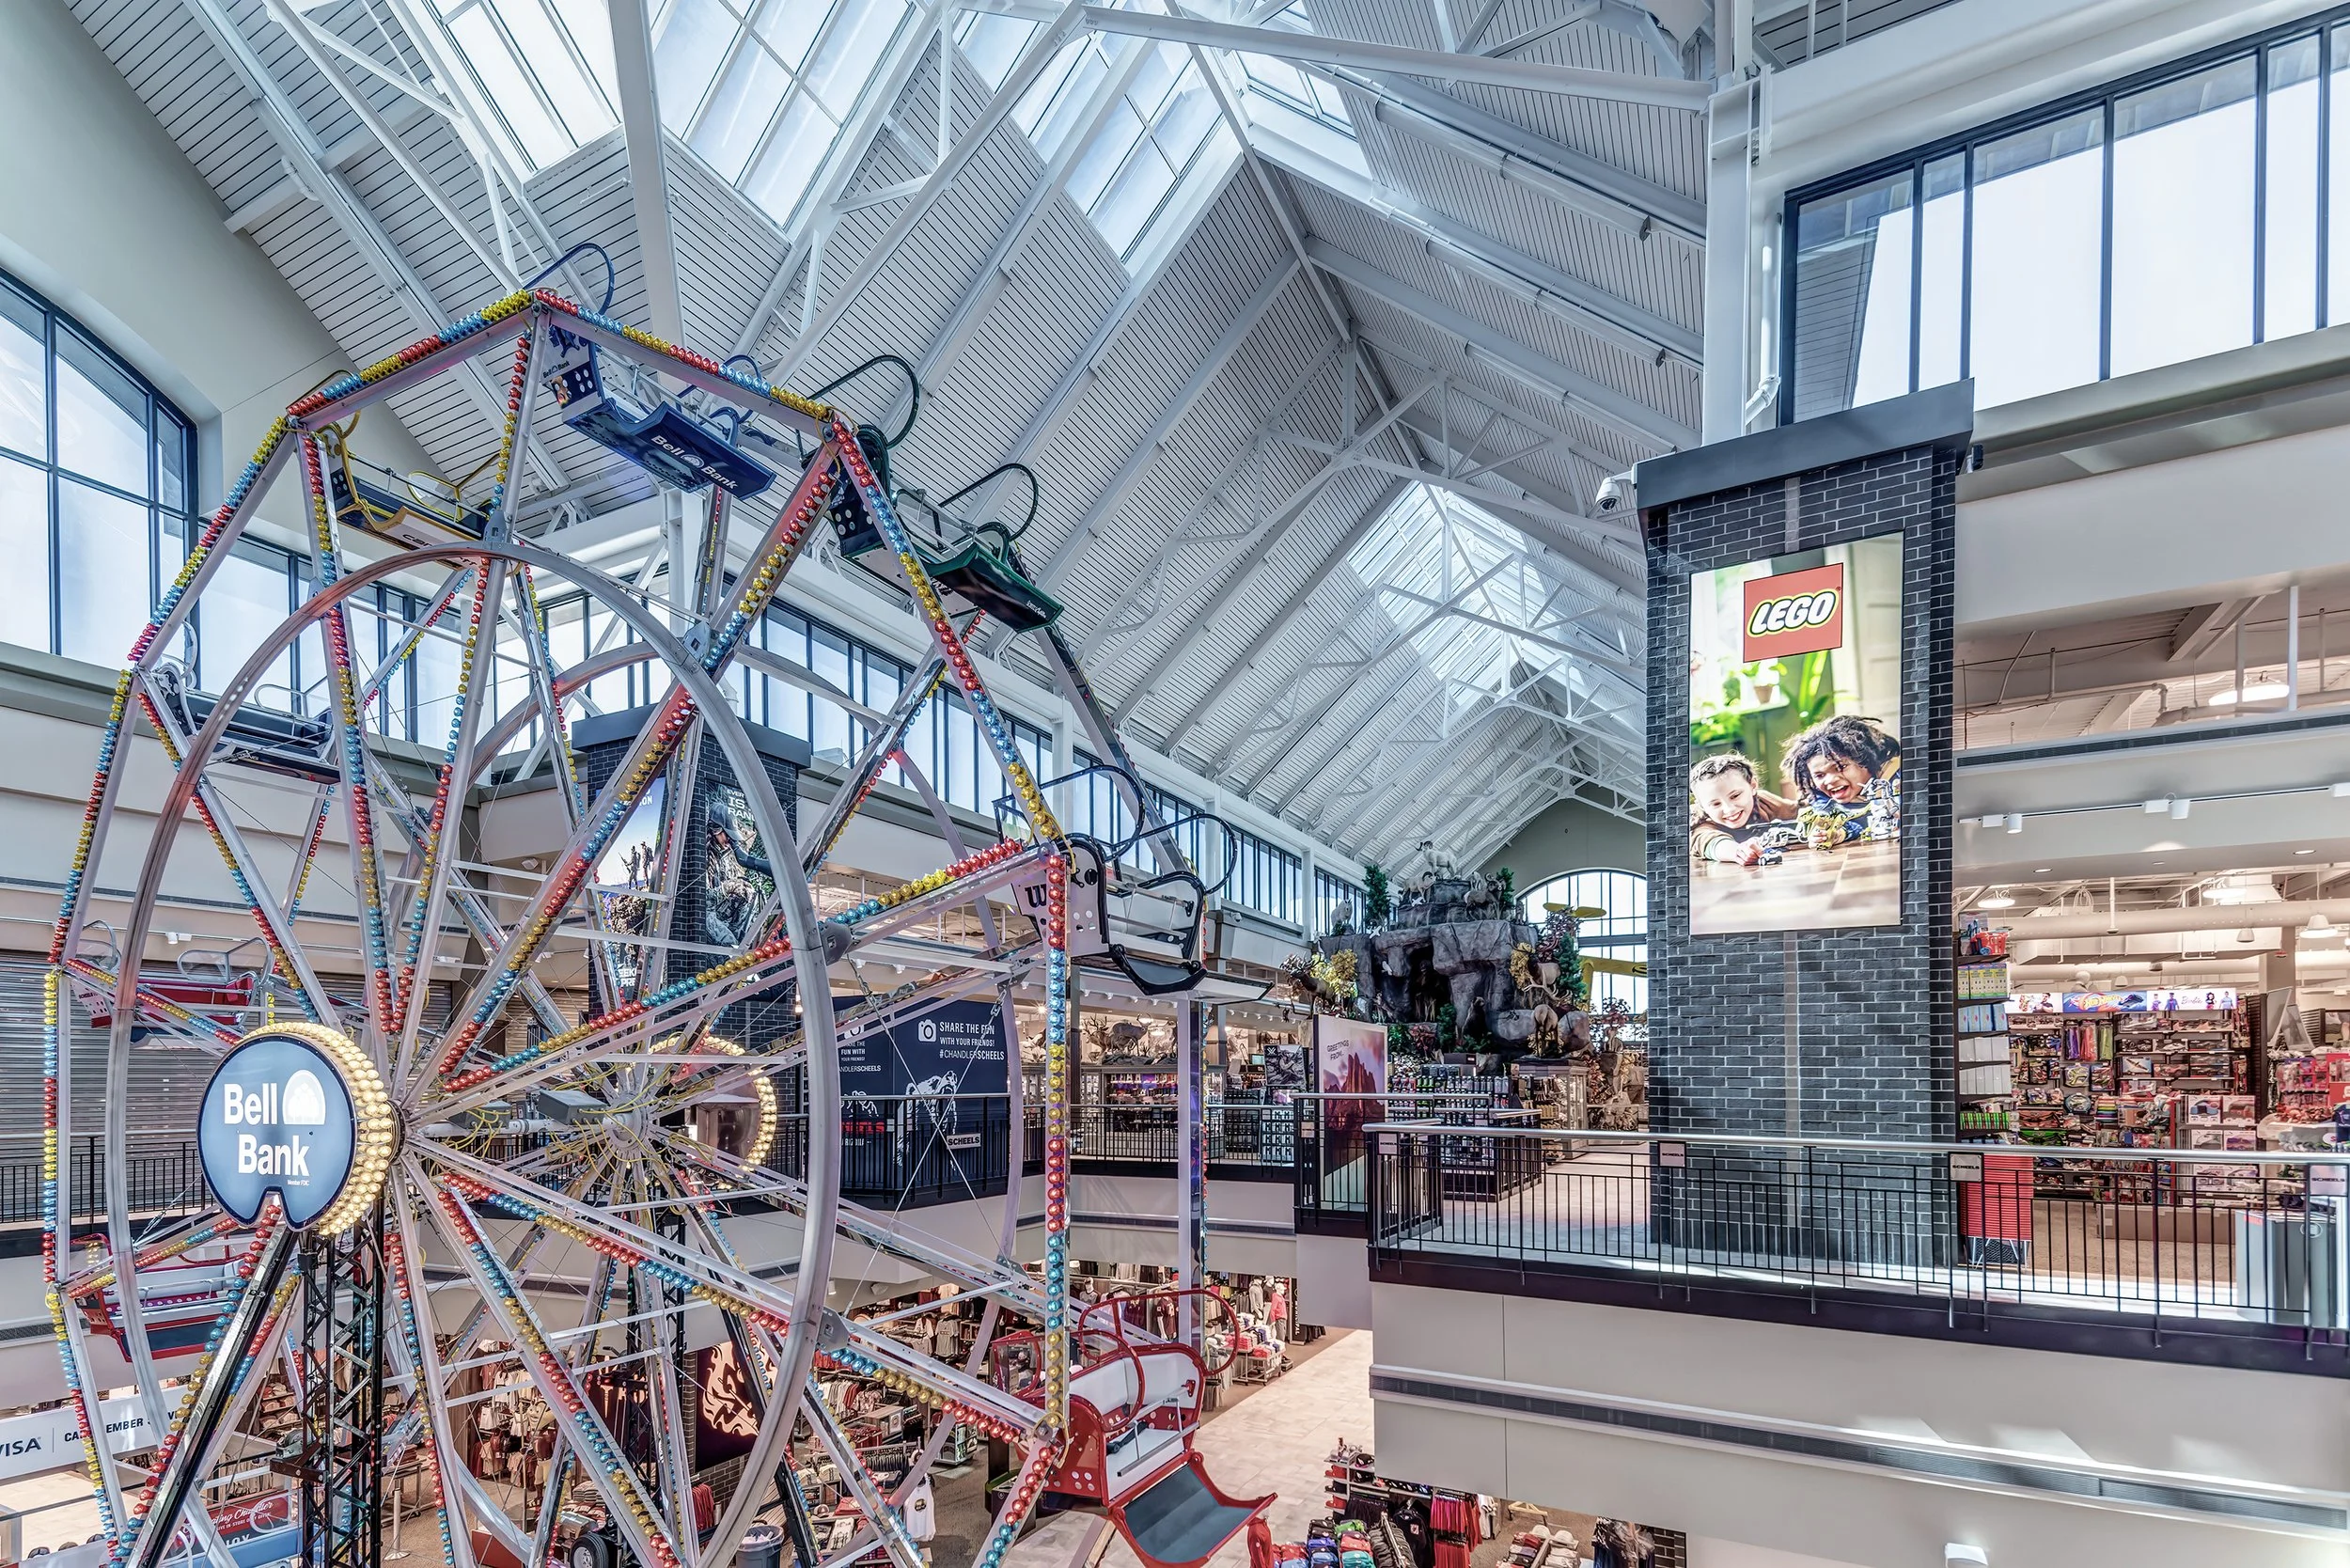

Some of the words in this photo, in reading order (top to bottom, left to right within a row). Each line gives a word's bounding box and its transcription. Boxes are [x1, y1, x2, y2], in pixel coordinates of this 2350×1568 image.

[650, 434, 684, 457] Bell
[701, 465, 738, 490] Bank
[1749, 590, 1837, 635] LEGO
[728, 796, 745, 809] IS
[939, 1021, 964, 1033] SHARE
[965, 1023, 979, 1034] THE
[940, 1037, 955, 1045] WITH
[224, 1082, 278, 1125] Bell
[238, 1134, 310, 1177] Bank
[948, 1136, 980, 1147] SCHEELS
